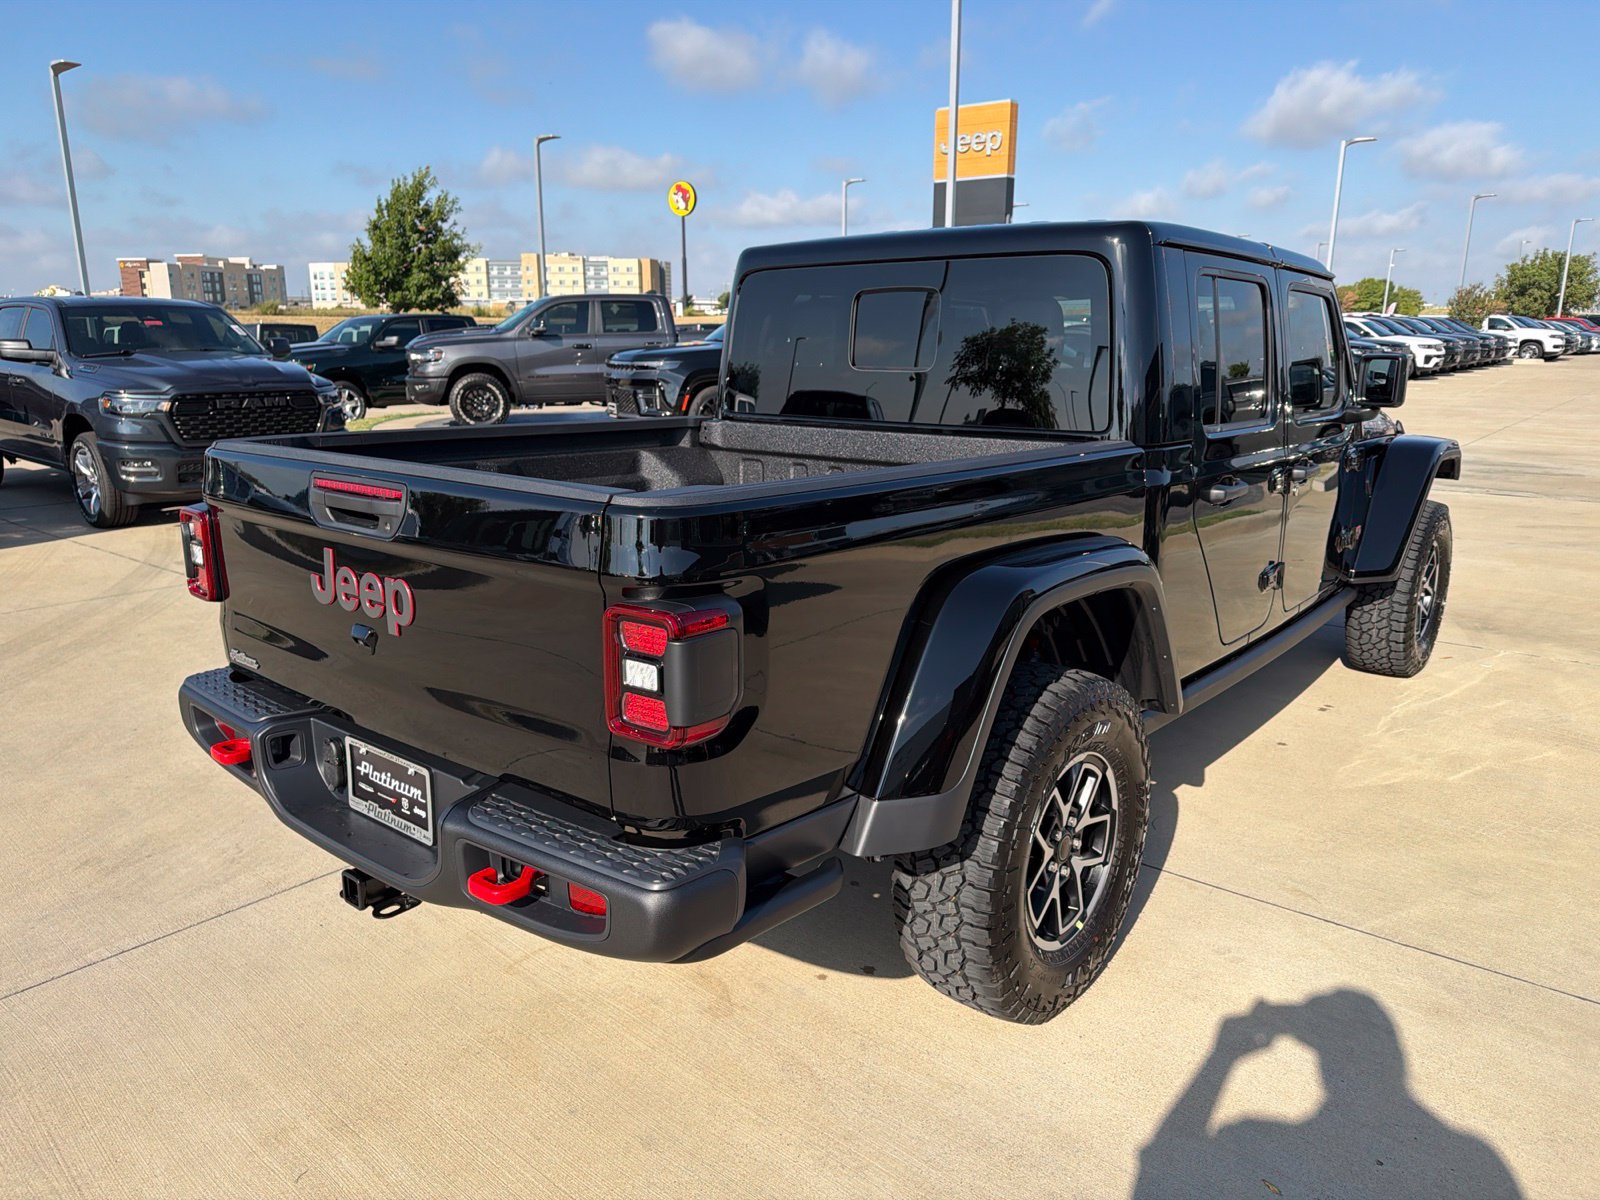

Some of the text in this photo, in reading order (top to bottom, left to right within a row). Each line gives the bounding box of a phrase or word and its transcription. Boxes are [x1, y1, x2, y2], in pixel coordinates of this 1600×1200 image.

[310, 547, 415, 637] Jeep
[356, 760, 426, 804] Platinum
[366, 801, 416, 837] Platinum
